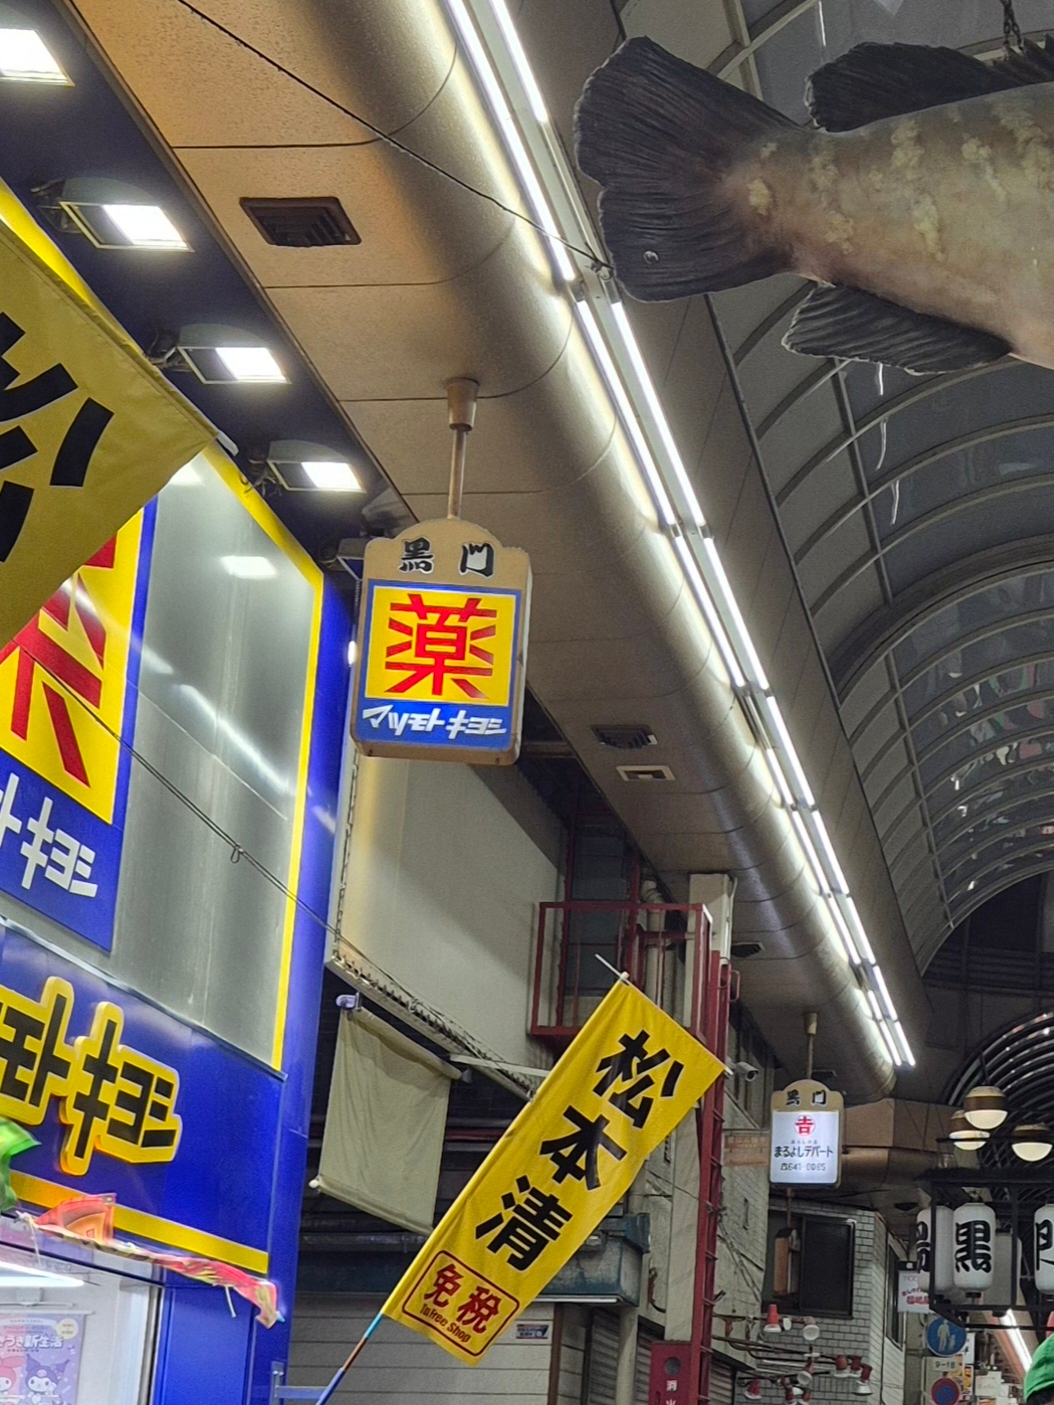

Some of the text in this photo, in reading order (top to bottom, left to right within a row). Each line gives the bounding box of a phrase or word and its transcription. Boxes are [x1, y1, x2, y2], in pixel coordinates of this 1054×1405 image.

[399, 537, 495, 577] 黒門
[384, 593, 498, 699] 薬
[362, 705, 507, 739] マツモトキヨシ
[475, 1029, 685, 1272] 松本清
[424, 1264, 502, 1334] 免税
[447, 1322, 472, 1343] Shop
